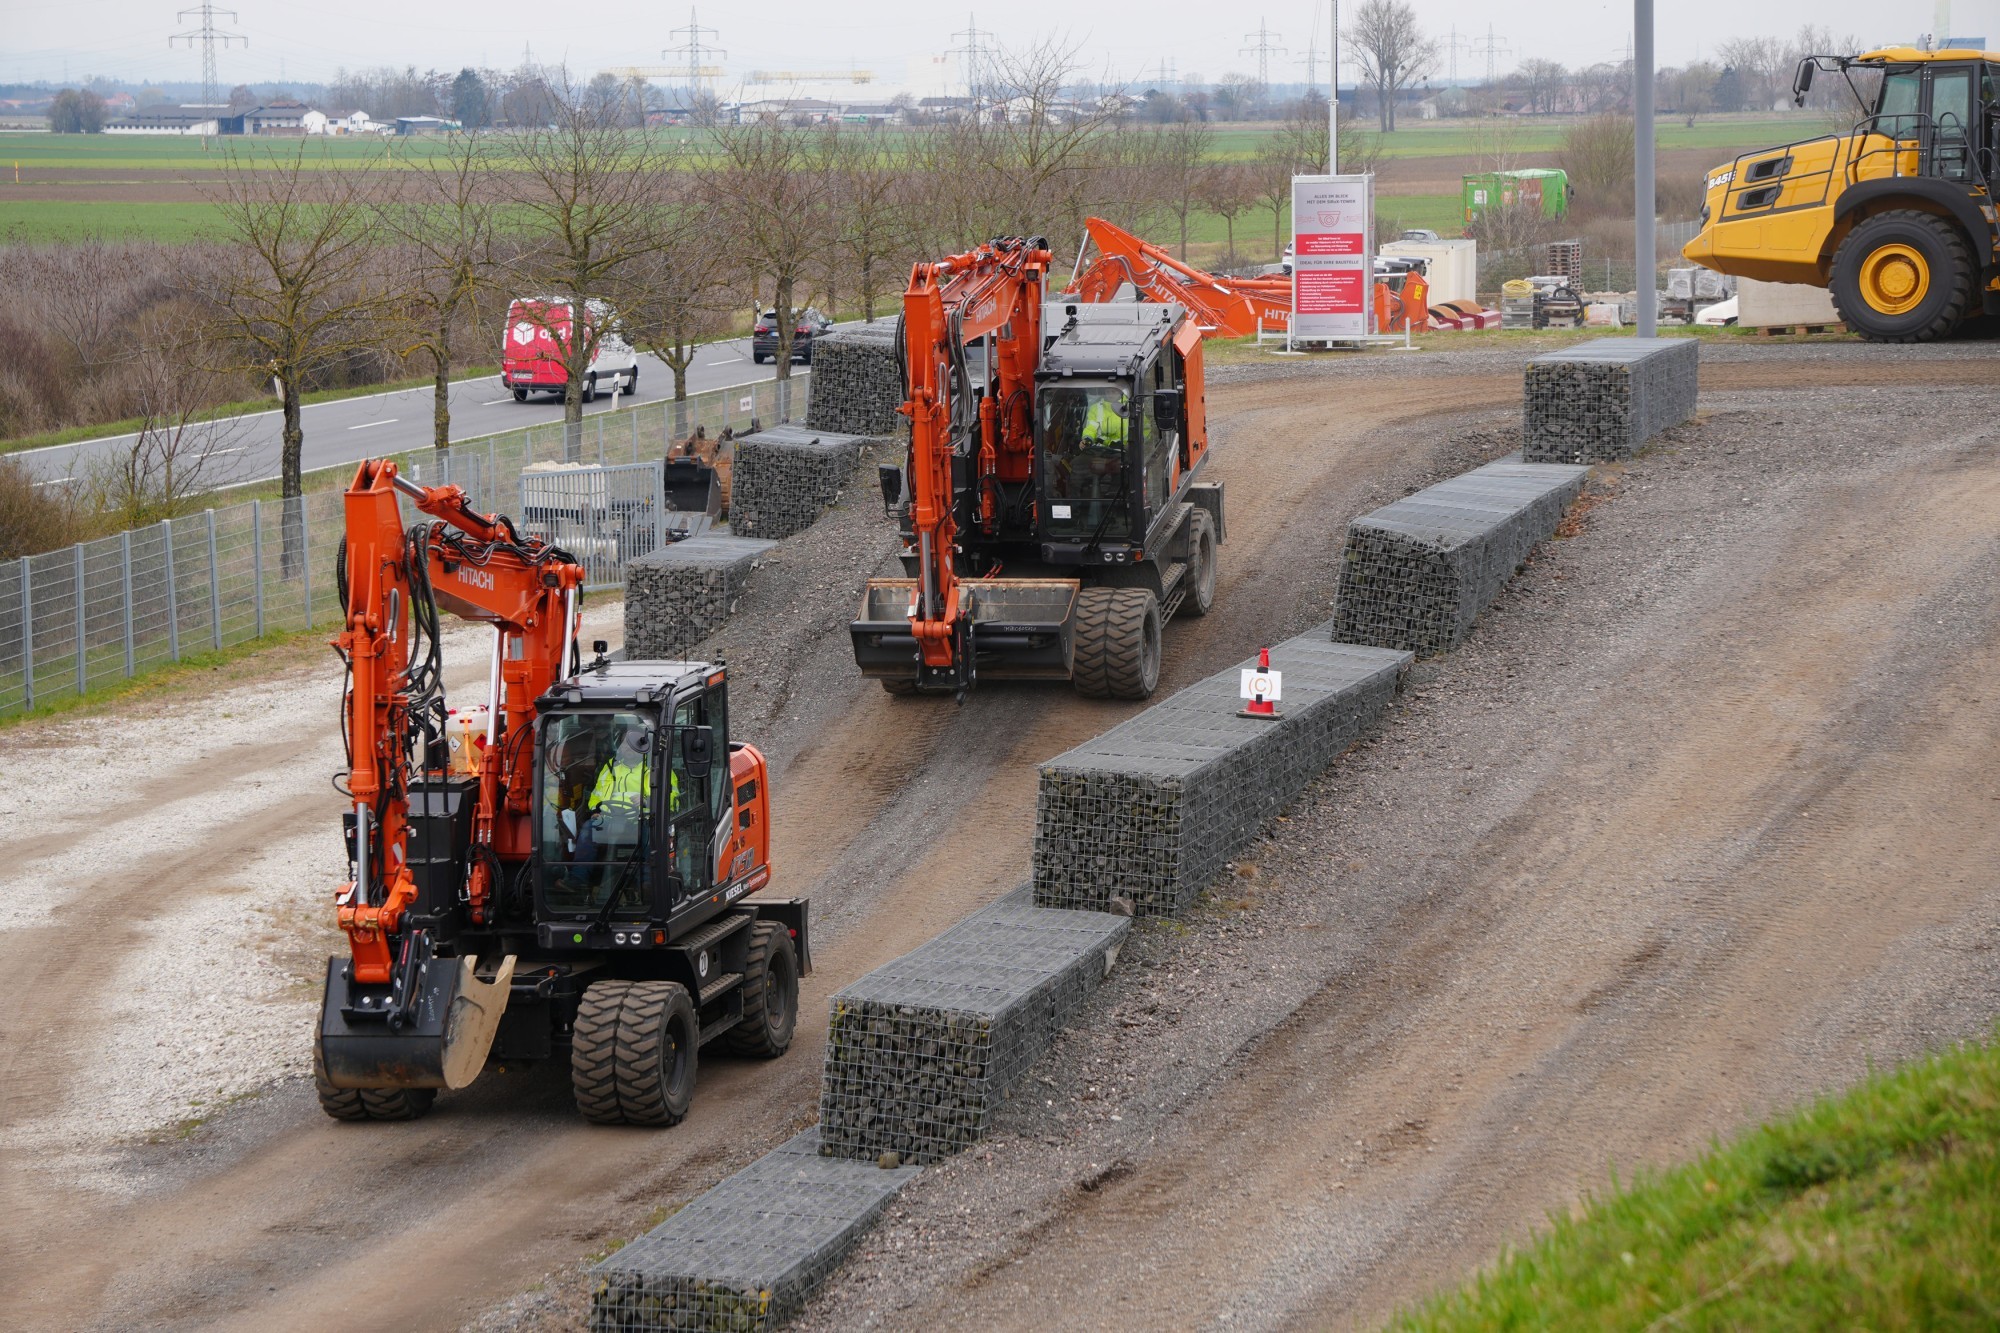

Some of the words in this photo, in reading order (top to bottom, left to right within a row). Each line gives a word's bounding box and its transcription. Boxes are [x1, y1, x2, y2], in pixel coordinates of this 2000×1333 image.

[976, 296, 997, 324] HITACHI
[1150, 281, 1198, 321] HITACHI
[458, 565, 494, 591] HITACHI
[1248, 677, 1273, 697] (C)
[725, 883, 743, 901] KIESEL
